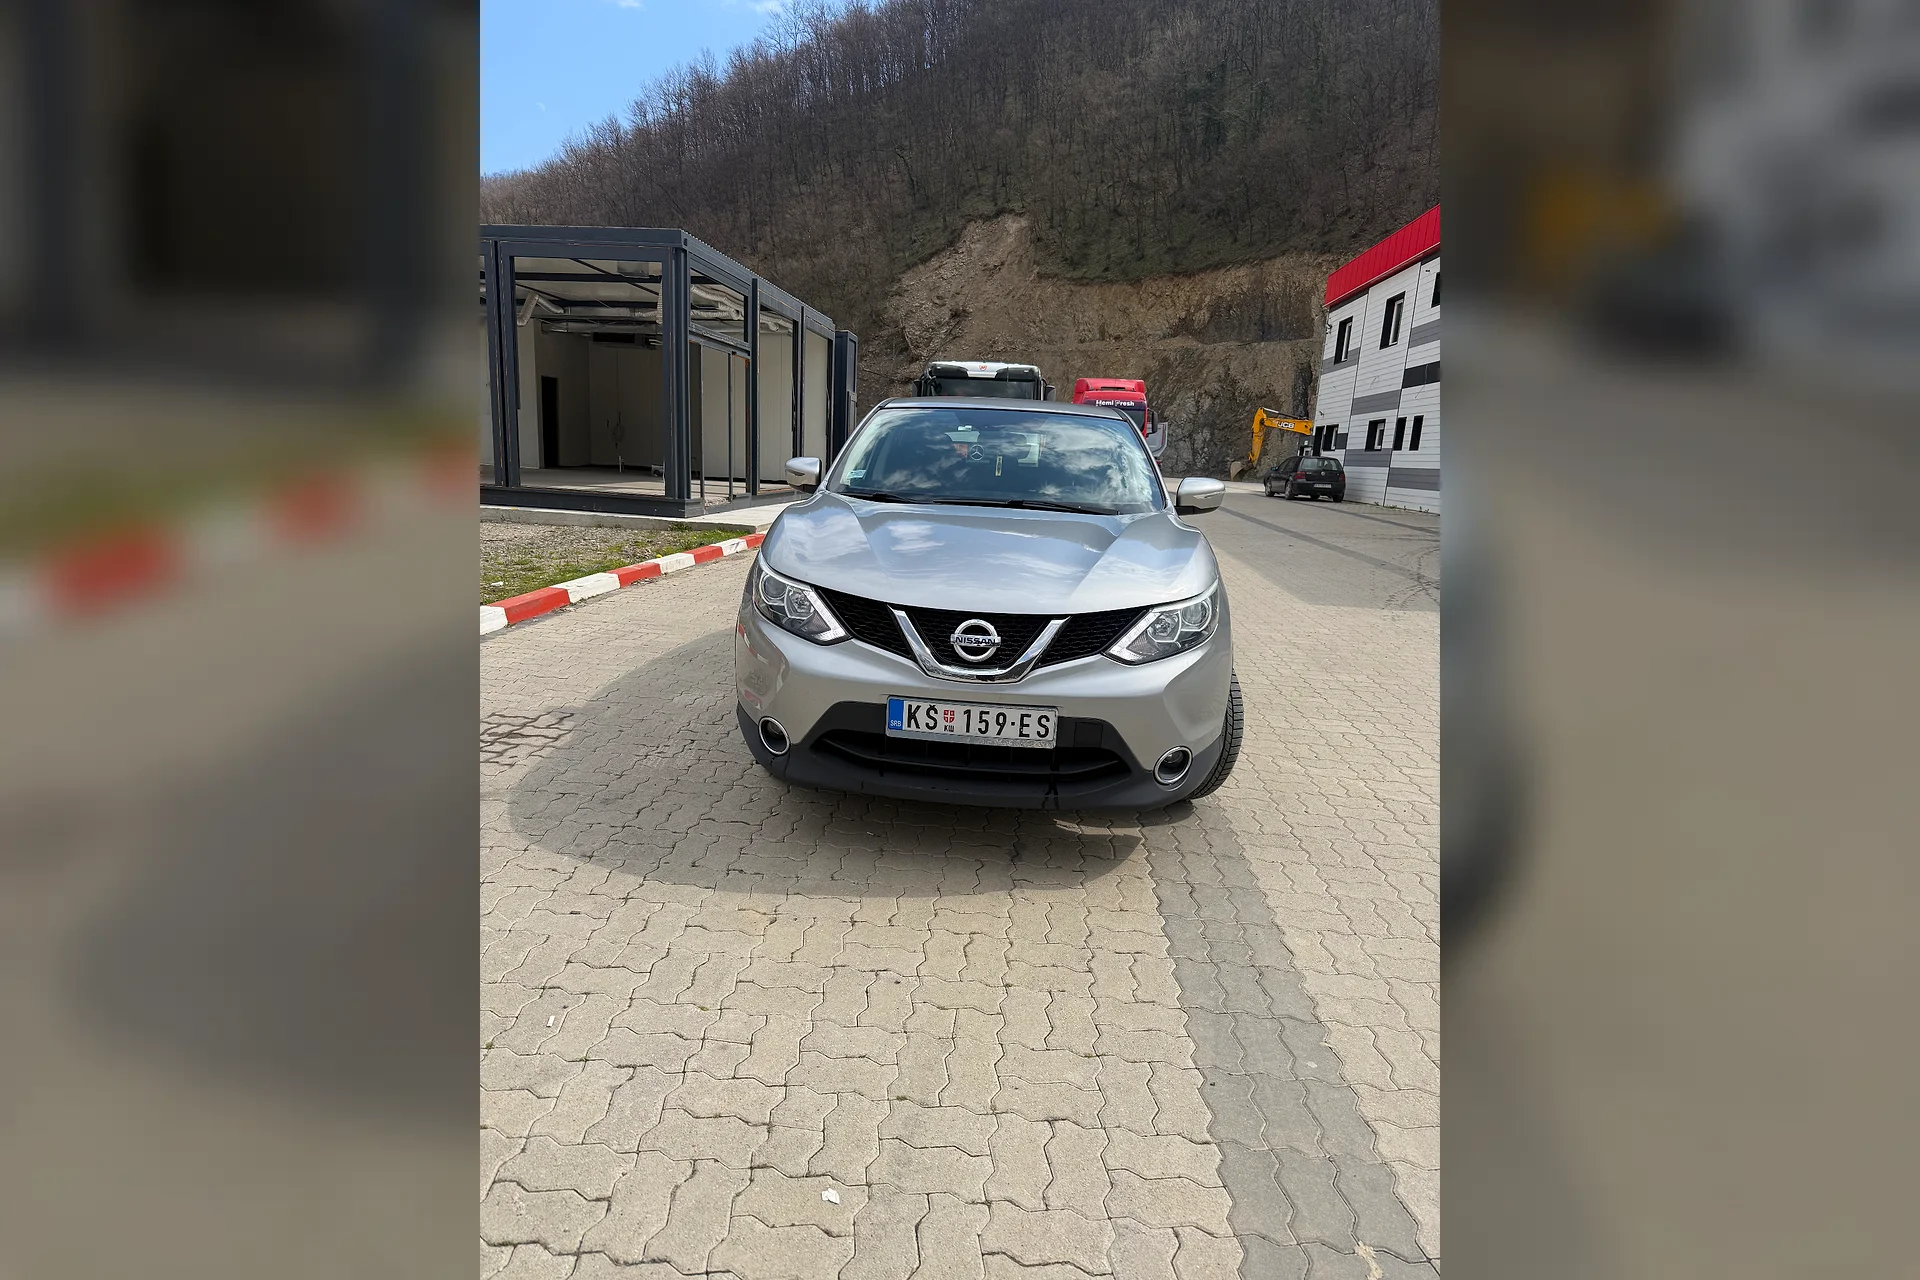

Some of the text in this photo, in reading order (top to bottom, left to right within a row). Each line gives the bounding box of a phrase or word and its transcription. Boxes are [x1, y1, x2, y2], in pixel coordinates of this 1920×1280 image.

[1278, 421, 1295, 429] JCB
[955, 636, 996, 645] NISSAN
[906, 704, 939, 731] KŠ
[889, 719, 902, 727] SRB
